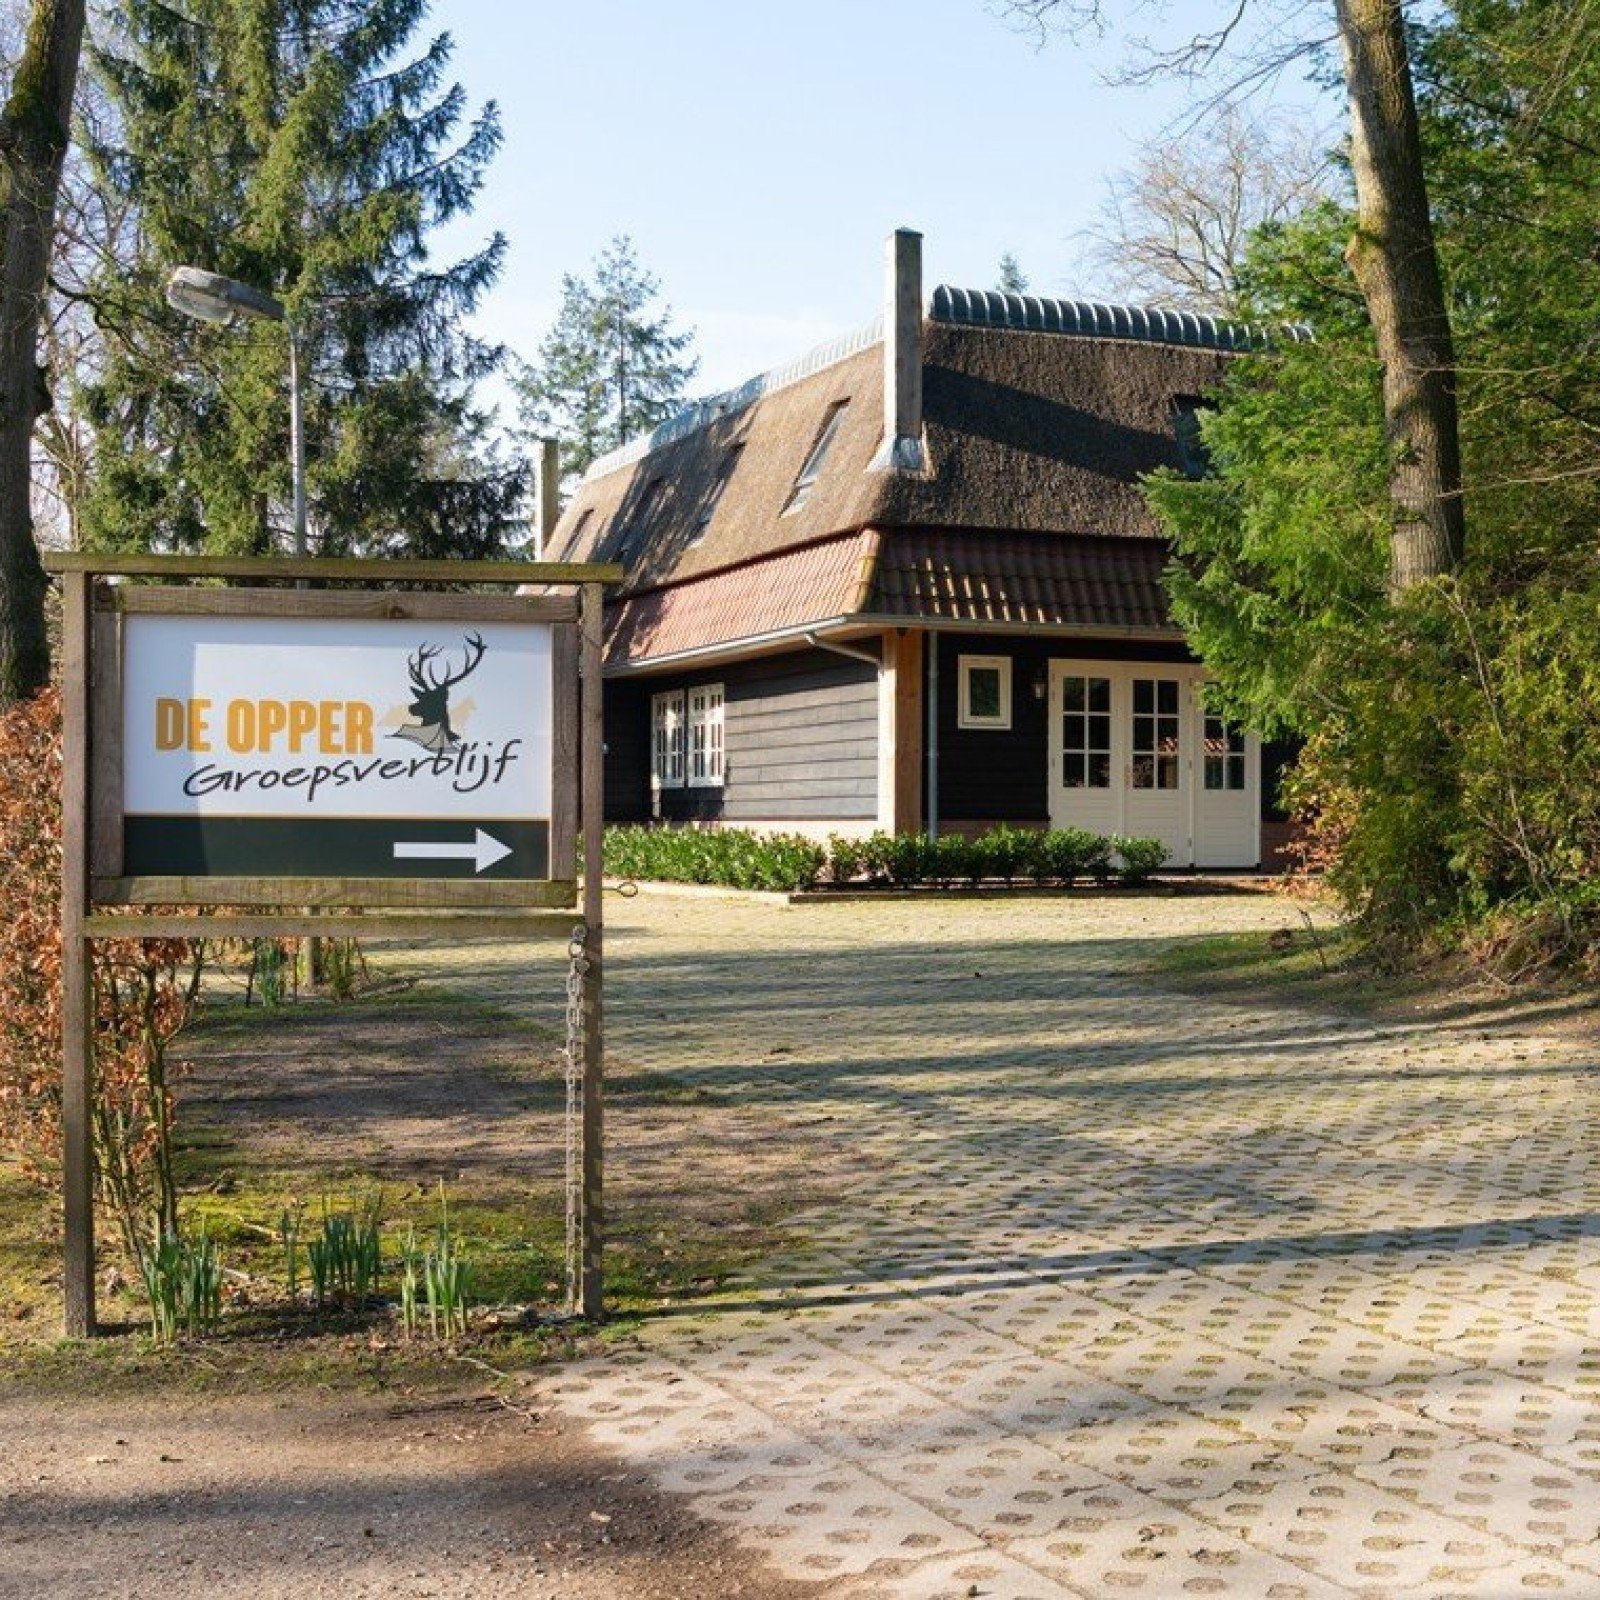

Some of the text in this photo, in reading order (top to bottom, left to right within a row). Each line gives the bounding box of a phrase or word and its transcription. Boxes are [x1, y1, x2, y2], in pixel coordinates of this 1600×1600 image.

[155, 698, 374, 755] DE OPPER
[183, 738, 522, 802] Groepsverblijf
